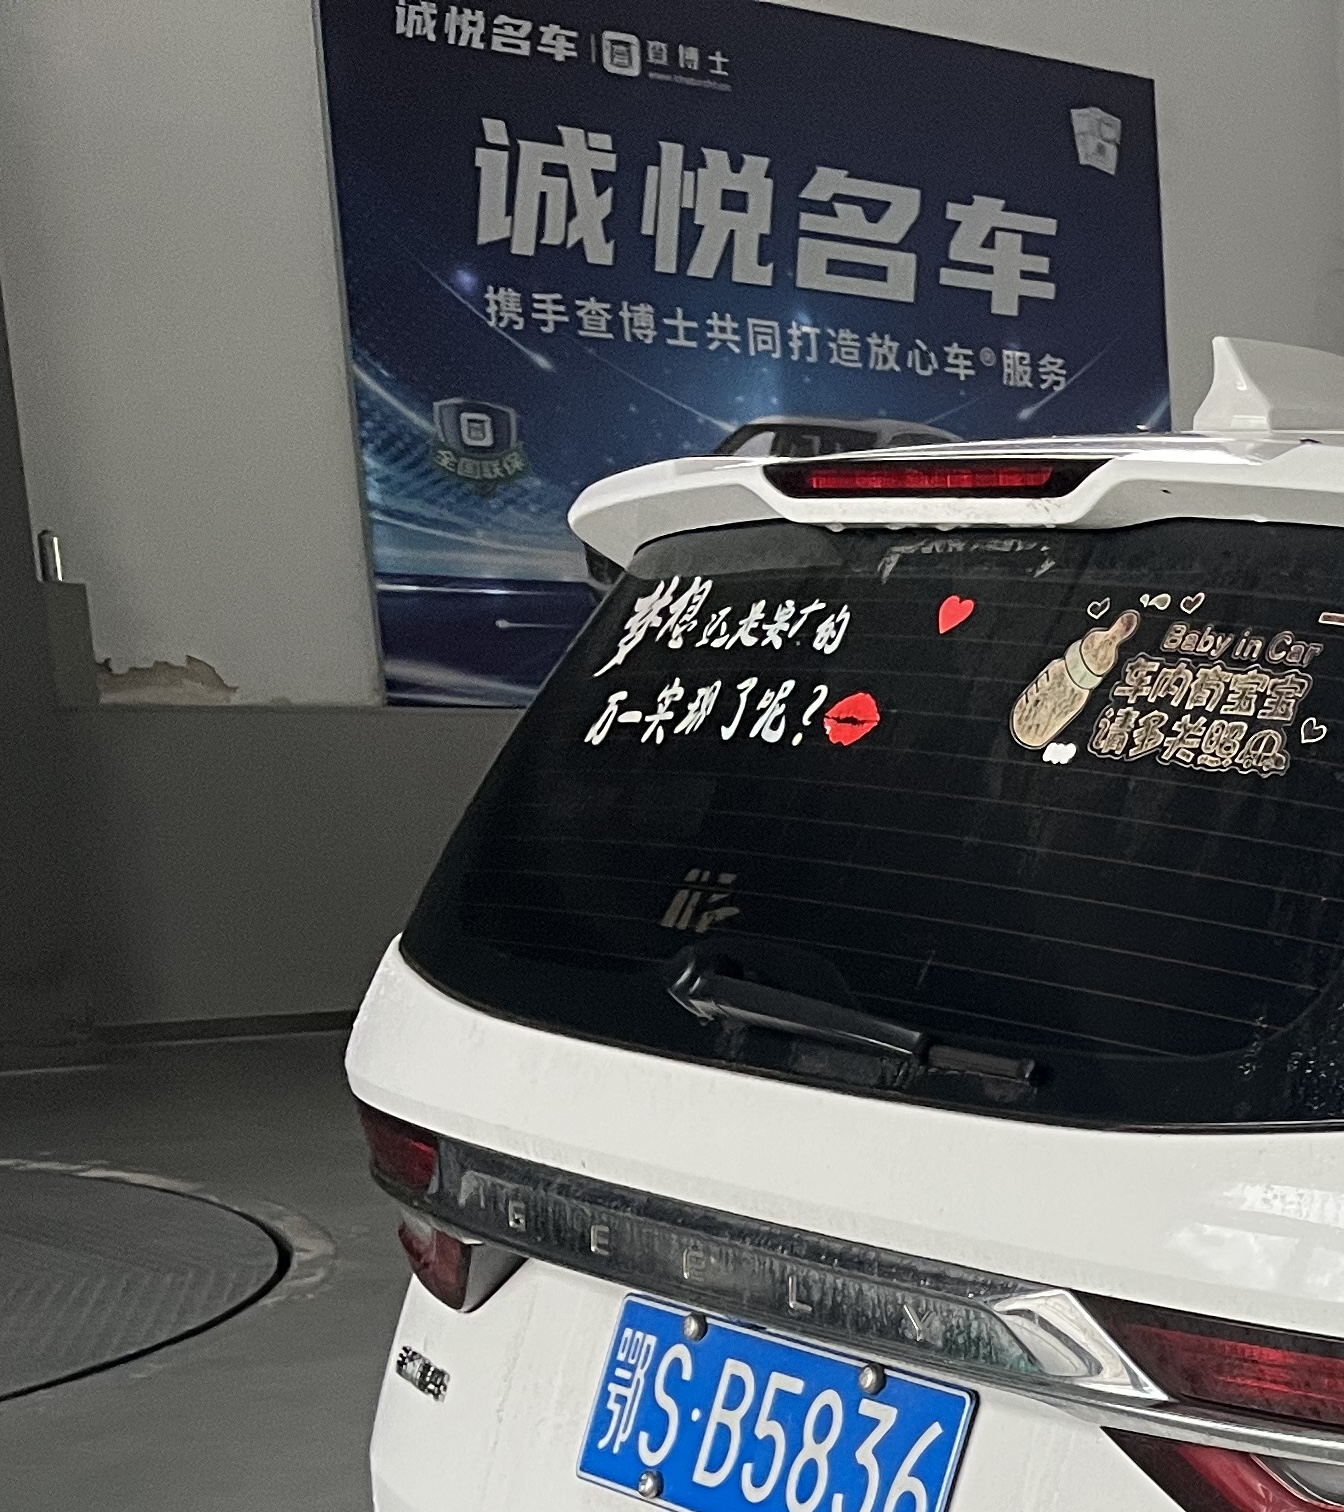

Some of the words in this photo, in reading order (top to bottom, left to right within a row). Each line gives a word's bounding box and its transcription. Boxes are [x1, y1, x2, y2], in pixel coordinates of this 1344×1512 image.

[395, 0, 579, 62] 诚悦名车
[475, 118, 1058, 317] 诚悦名车
[1161, 620, 1232, 659] Baby
[1233, 629, 1263, 661] in
[1265, 630, 1324, 667] Car
[1113, 656, 1306, 723] 车内有宝宝
[1093, 706, 1250, 768] 请多关照
[507, 1197, 934, 1343] GEELY
